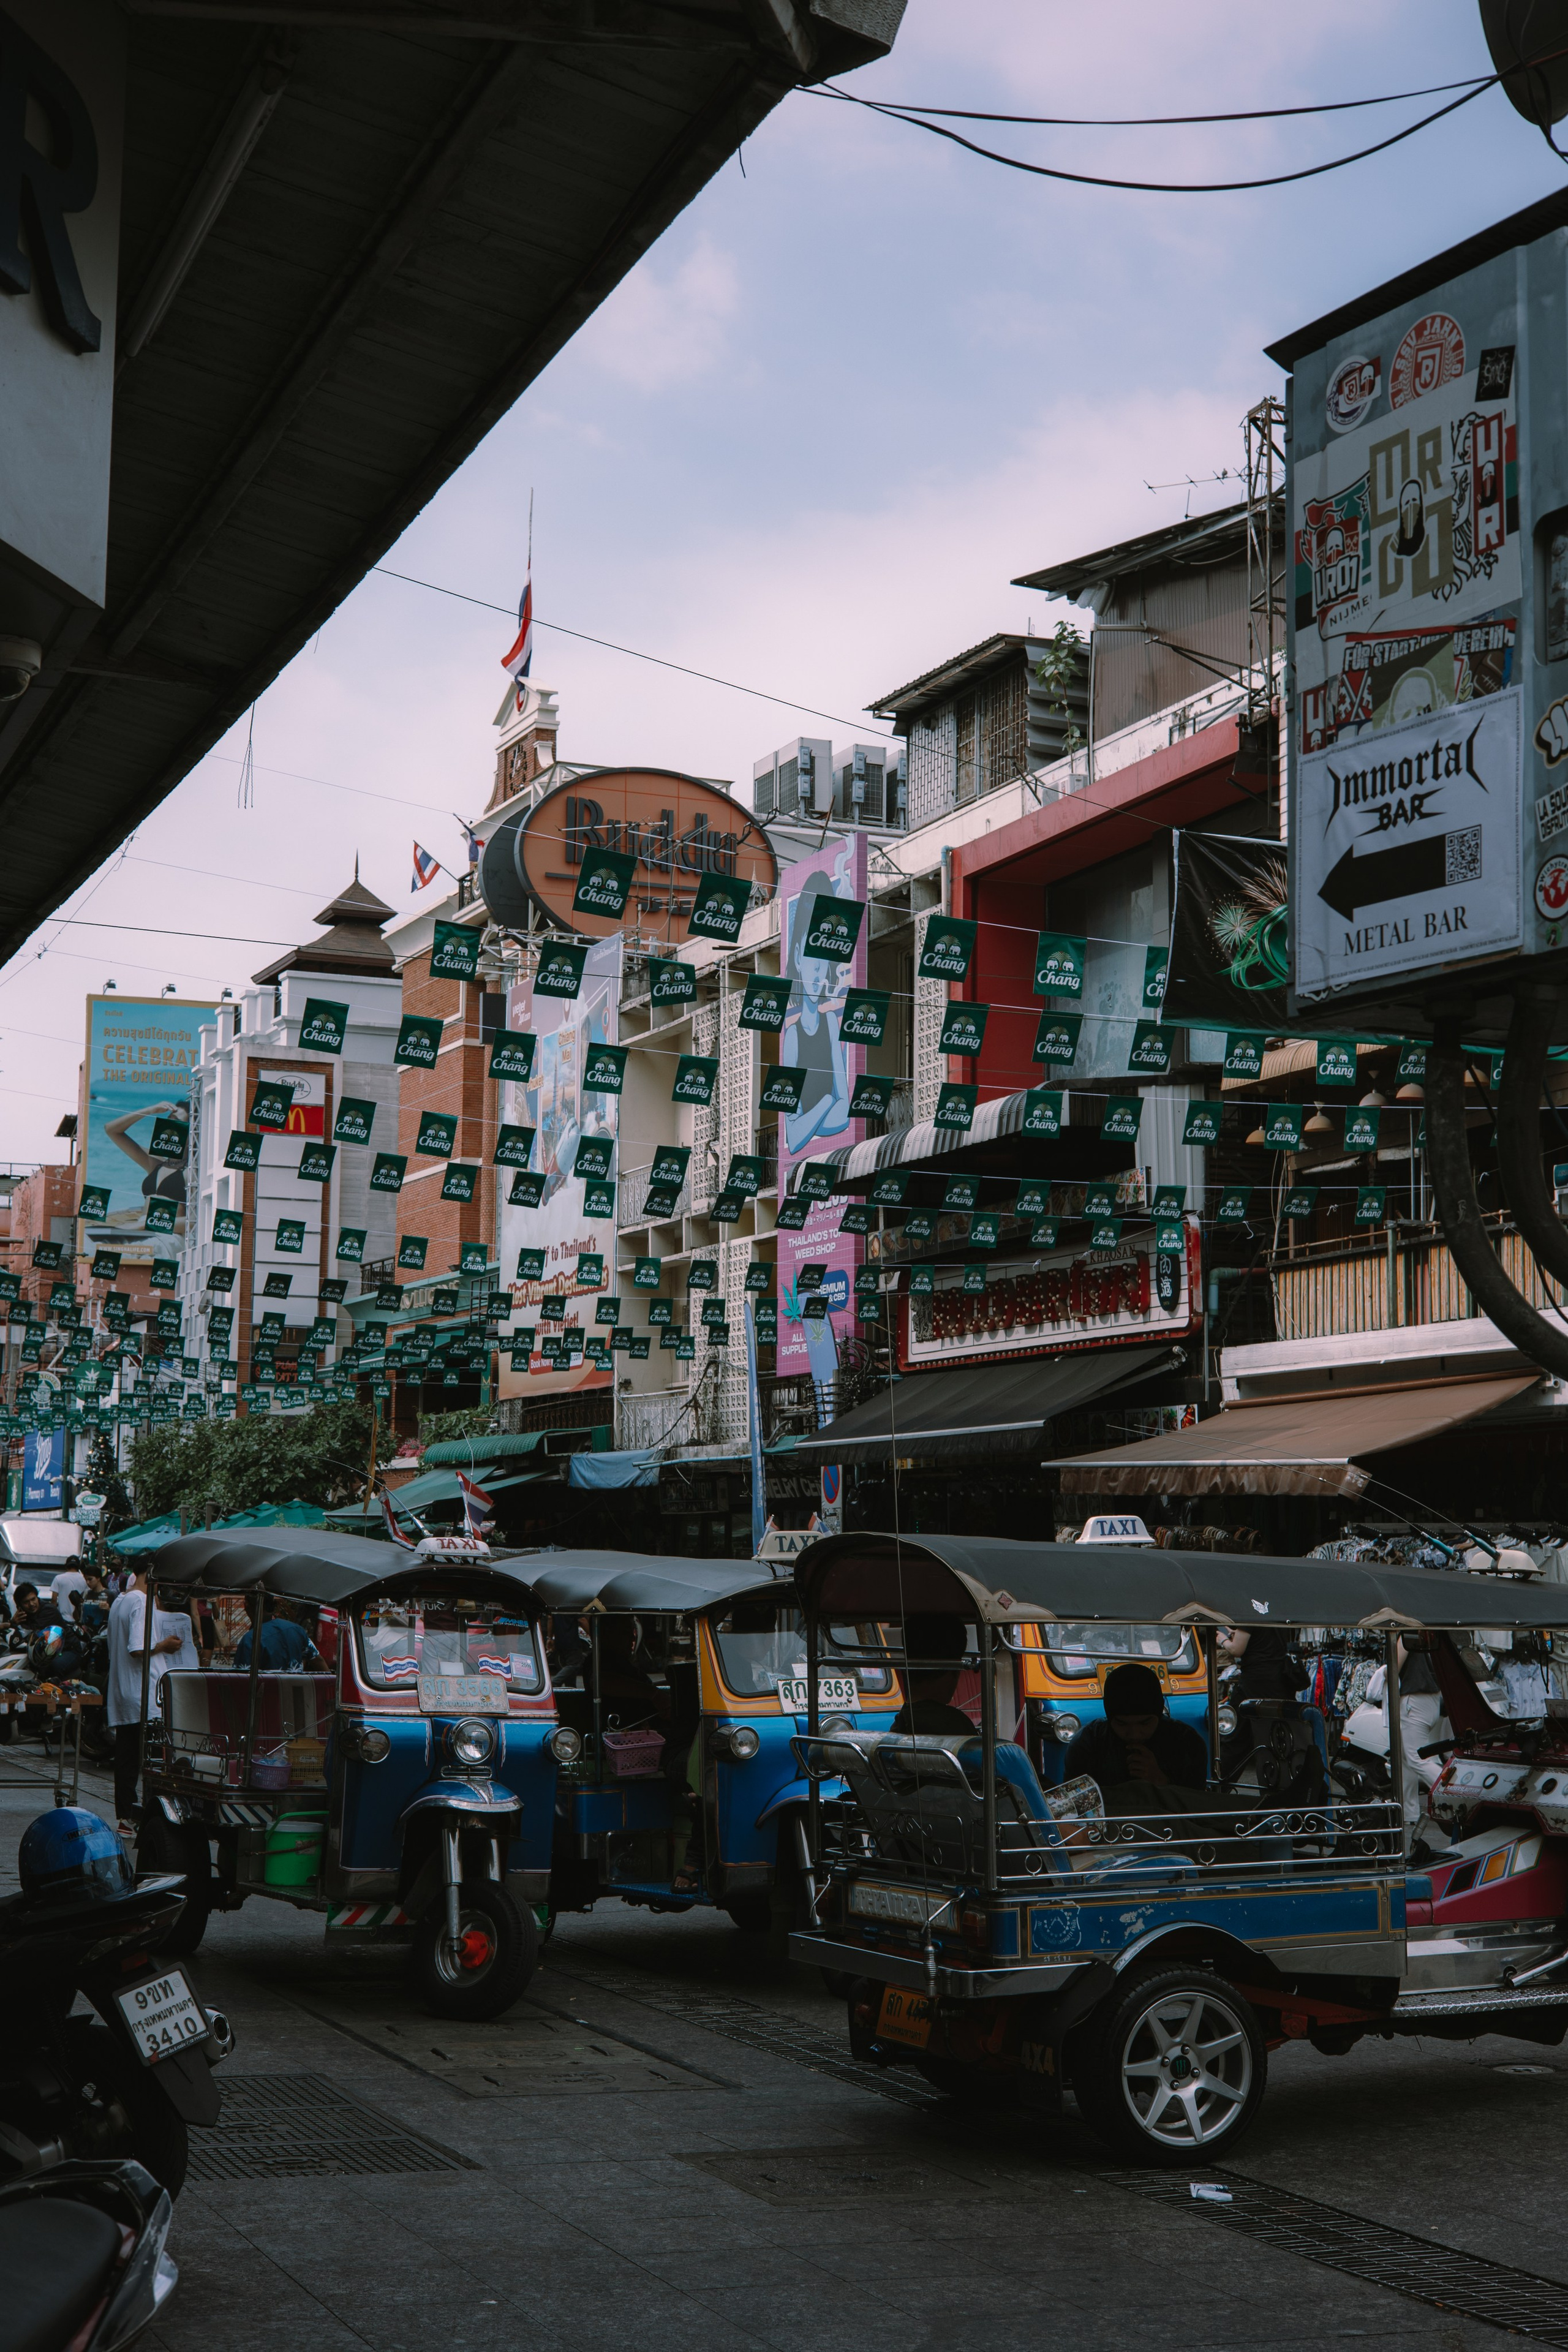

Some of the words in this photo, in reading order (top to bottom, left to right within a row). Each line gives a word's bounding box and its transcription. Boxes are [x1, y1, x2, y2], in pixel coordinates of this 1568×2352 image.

[1395, 328, 1417, 371] SSV
[1423, 316, 1463, 345] JAHN
[1330, 594, 1370, 627] NIJME
[1453, 624, 1506, 655] VEREIN
[1355, 787, 1446, 838] BAR
[578, 886, 624, 910] Chang
[693, 910, 739, 933] Chang
[1344, 918, 1415, 957] METAL
[1424, 905, 1468, 938] BAR
[809, 932, 853, 954] Chang
[433, 953, 474, 973] Chang
[922, 952, 966, 974] Chang
[538, 972, 578, 991] Chang
[1037, 970, 1080, 990] Chang
[652, 980, 694, 998] Chang
[743, 1007, 782, 1025] Chang
[104, 1026, 192, 1043] ความสุขมีได้ทุกวัน
[303, 1028, 341, 1046] Chang
[559, 1028, 575, 1047] Chiang
[843, 1020, 882, 1038] Chang
[943, 1031, 981, 1049] Chang
[103, 1044, 198, 1067] CELEBRAT
[398, 1044, 435, 1061] Chang
[562, 1047, 571, 1065] Mai
[1036, 1041, 1073, 1058] Chang
[1132, 1050, 1167, 1066] Chang
[492, 1058, 529, 1075] Chang
[1225, 1057, 1260, 1072] Chang
[1319, 1063, 1354, 1079] Chang
[1399, 1063, 1425, 1074] Chan
[103, 1069, 126, 1082] THE
[586, 1070, 621, 1087] Chang
[676, 1082, 710, 1099] Chang
[763, 1091, 797, 1107] Chang
[252, 1106, 285, 1123] Chang
[851, 1100, 884, 1114] Chang
[937, 1109, 971, 1125] Chang
[1025, 1117, 1058, 1132] Chang
[336, 1122, 368, 1139] Chang
[1104, 1121, 1137, 1135] Chang
[1186, 1127, 1216, 1140] Chang
[419, 1136, 451, 1152] Chang
[1267, 1130, 1298, 1144] Chang
[1345, 1133, 1376, 1145] Chang
[152, 1139, 183, 1154] Chang
[497, 1148, 528, 1163] Chang
[577, 1160, 607, 1175] Chang
[652, 1169, 682, 1183] Chang
[728, 1177, 758, 1192] Chang
[551, 1246, 558, 1261] to
[560, 1234, 596, 1260] Thailand's
[788, 1230, 829, 1248] THAILAND'S
[795, 1246, 815, 1260] WEED
[815, 1242, 836, 1255] SHOP
[1090, 1243, 1136, 1264] KHAOSAN
[35, 1257, 55, 1267] Chang
[527, 1276, 557, 1302] Vibrant
[50, 1298, 72, 1308] Chang
[834, 1294, 846, 1302] CBD
[488, 1308, 509, 1317] Chang
[597, 1313, 617, 1322] Chang
[649, 1314, 671, 1322] Chang
[535, 1319, 551, 1336] with
[792, 1334, 804, 1343] ALL
[782, 1344, 808, 1356] SUPPLIE
[530, 1357, 541, 1369] Book
[541, 1358, 552, 1367] Now!
[1096, 1519, 1139, 1536] TAXI
[436, 1537, 480, 1551] TAXI
[422, 1602, 442, 1611] TUK
[422, 1678, 450, 1696] สก
[456, 1678, 502, 1696] 3566
[782, 1679, 807, 1699] สก
[1087, 1683, 1098, 1695] 9
[1170, 1678, 1180, 1691] 9
[66, 1827, 93, 1840] INDEX
[855, 1887, 951, 1930] THAILAND
[135, 1978, 175, 2010] 9ขท
[886, 1992, 904, 2018] สก
[131, 1997, 195, 2034] กรุงเทพมหานคร
[146, 2016, 198, 2052] 3410
[1020, 2040, 1055, 2077] 4X4
